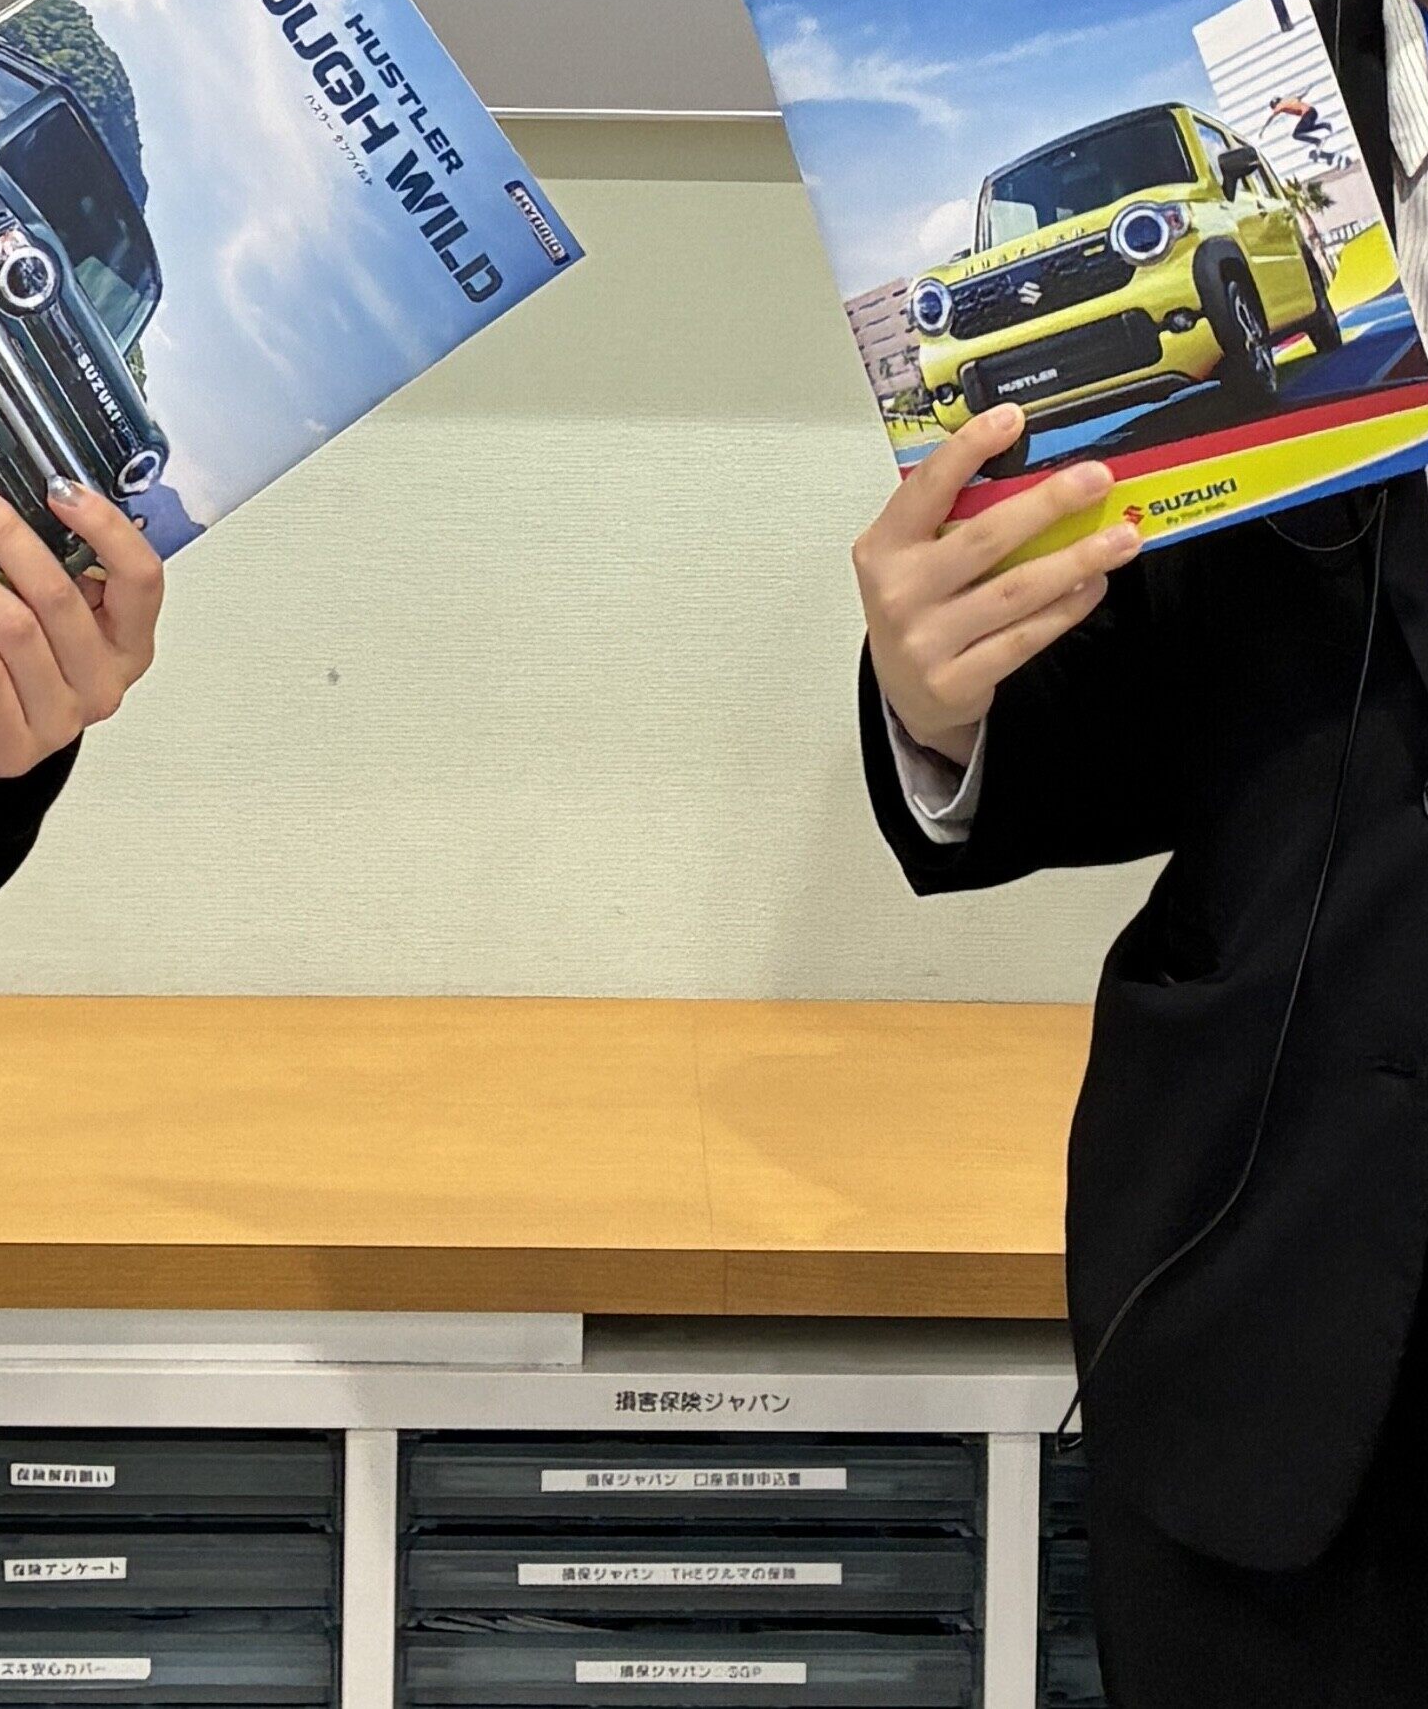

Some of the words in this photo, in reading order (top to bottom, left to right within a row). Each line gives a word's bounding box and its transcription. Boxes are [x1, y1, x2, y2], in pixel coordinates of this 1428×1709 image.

[344, 13, 464, 175] HUSTLER
[385, 150, 504, 304] WILD
[77, 354, 122, 422] SUZUKI
[998, 368, 1058, 395] HUSTLER
[1148, 477, 1238, 516] SUZUKI
[615, 1391, 790, 1413] 損害保険ジャパン
[586, 1473, 677, 1487] 損保ジャパン
[12, 1561, 120, 1576] 保険アンケート
[562, 1567, 653, 1581] 損保ジャパン
